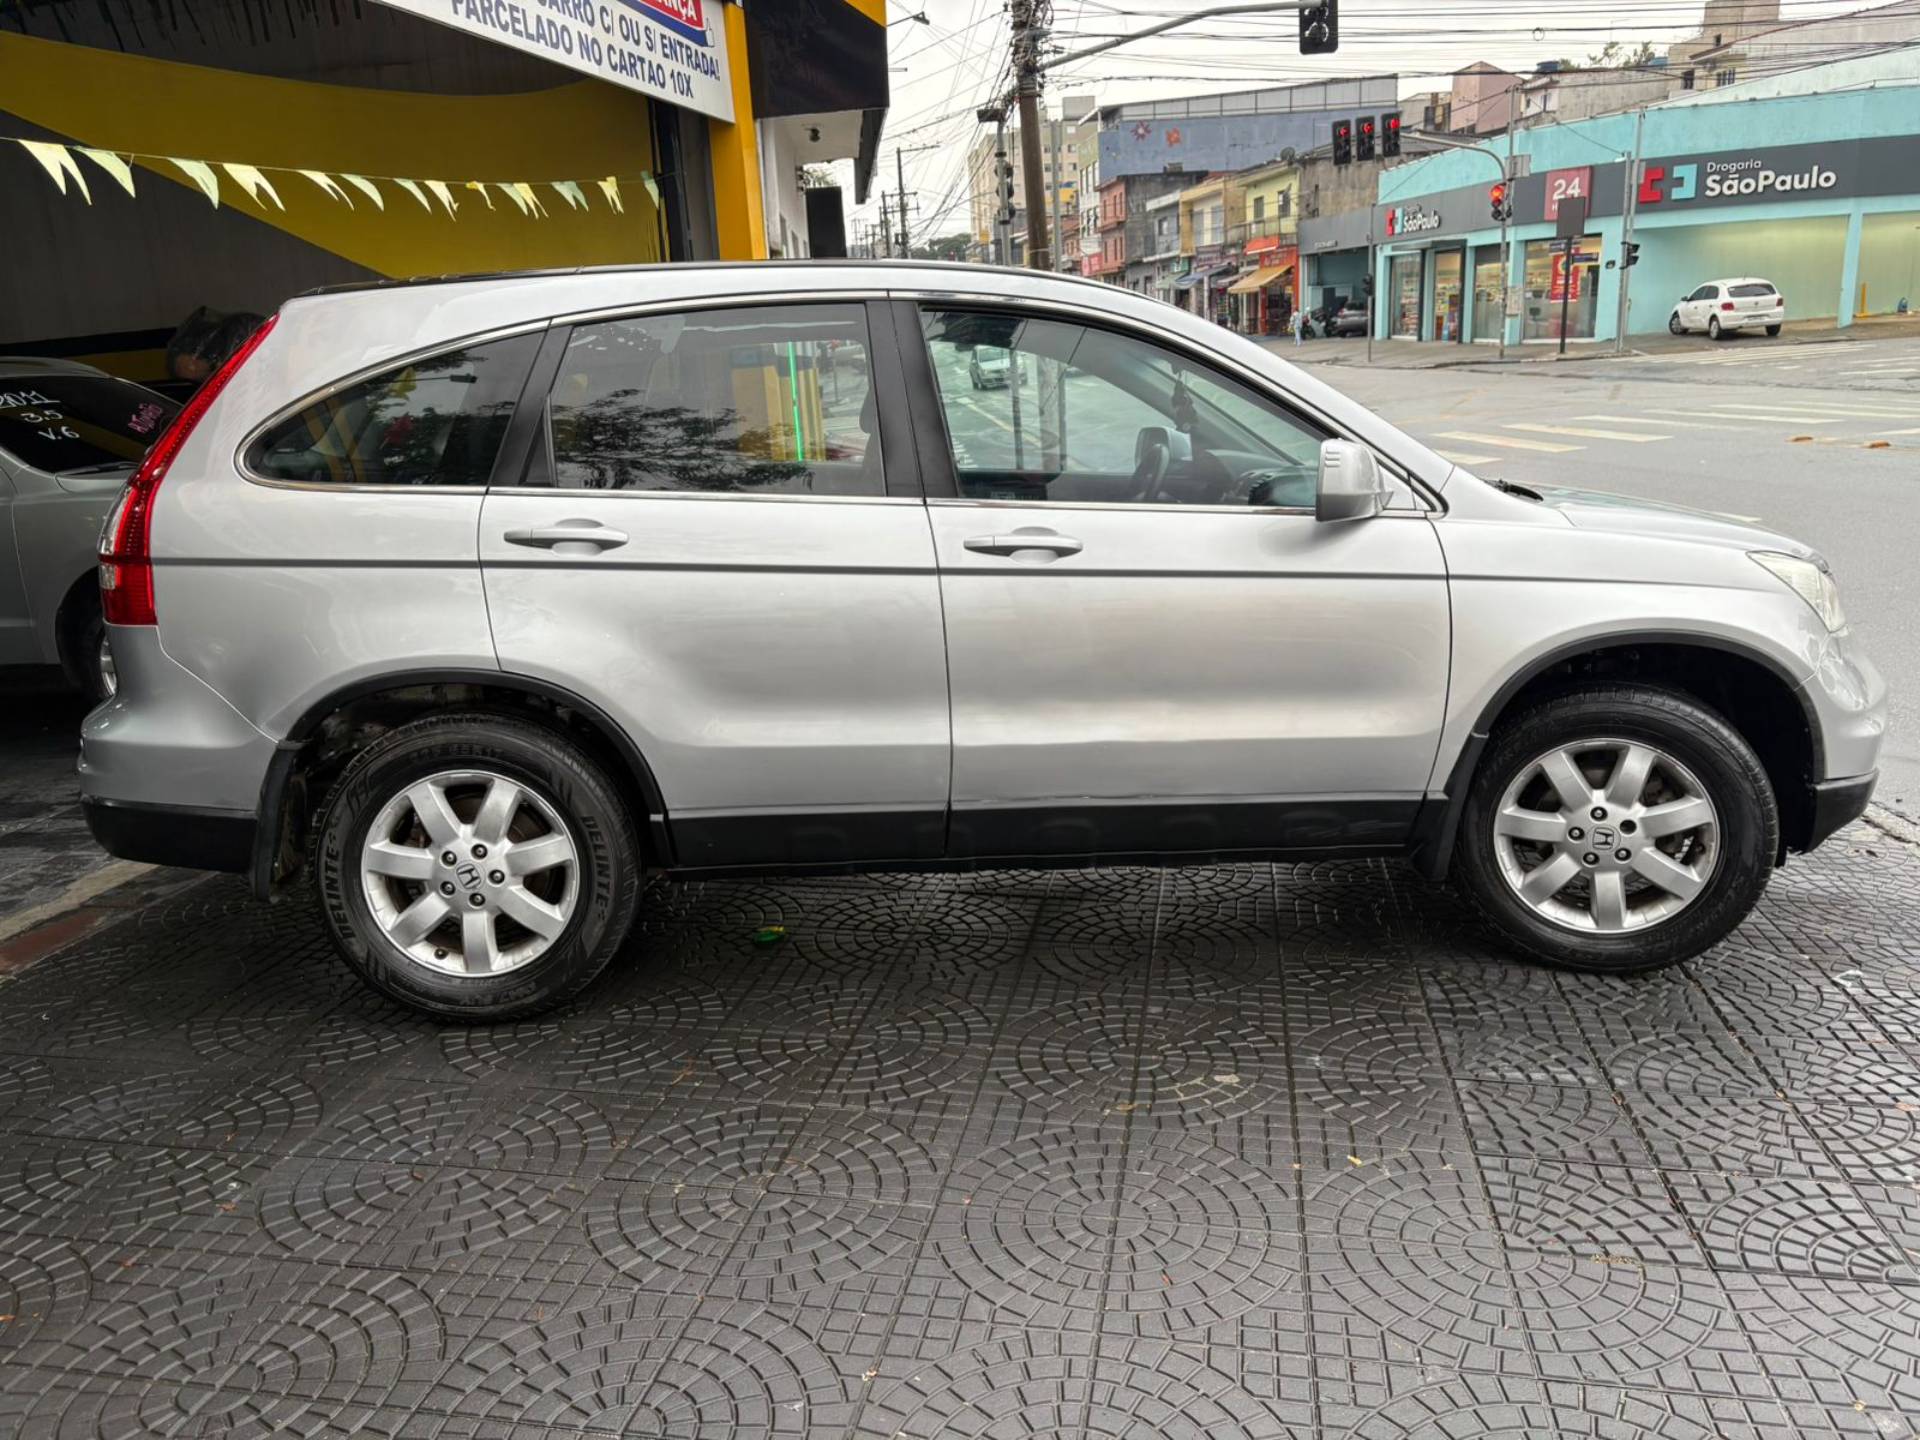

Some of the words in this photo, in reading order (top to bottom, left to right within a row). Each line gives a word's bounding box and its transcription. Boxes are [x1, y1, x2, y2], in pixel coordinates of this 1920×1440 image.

[538, 0, 595, 28] RRO
[619, 14, 640, 46] OU
[660, 33, 720, 81] ENTRADA!
[577, 30, 603, 67] NO
[670, 69, 694, 98] 10X
[1552, 177, 1581, 200] 24
[1706, 158, 1762, 174] Drogaria
[20, 409, 63, 423] 3.5
[325, 846, 356, 940] DELINTE
[581, 816, 611, 908] DELINTE
